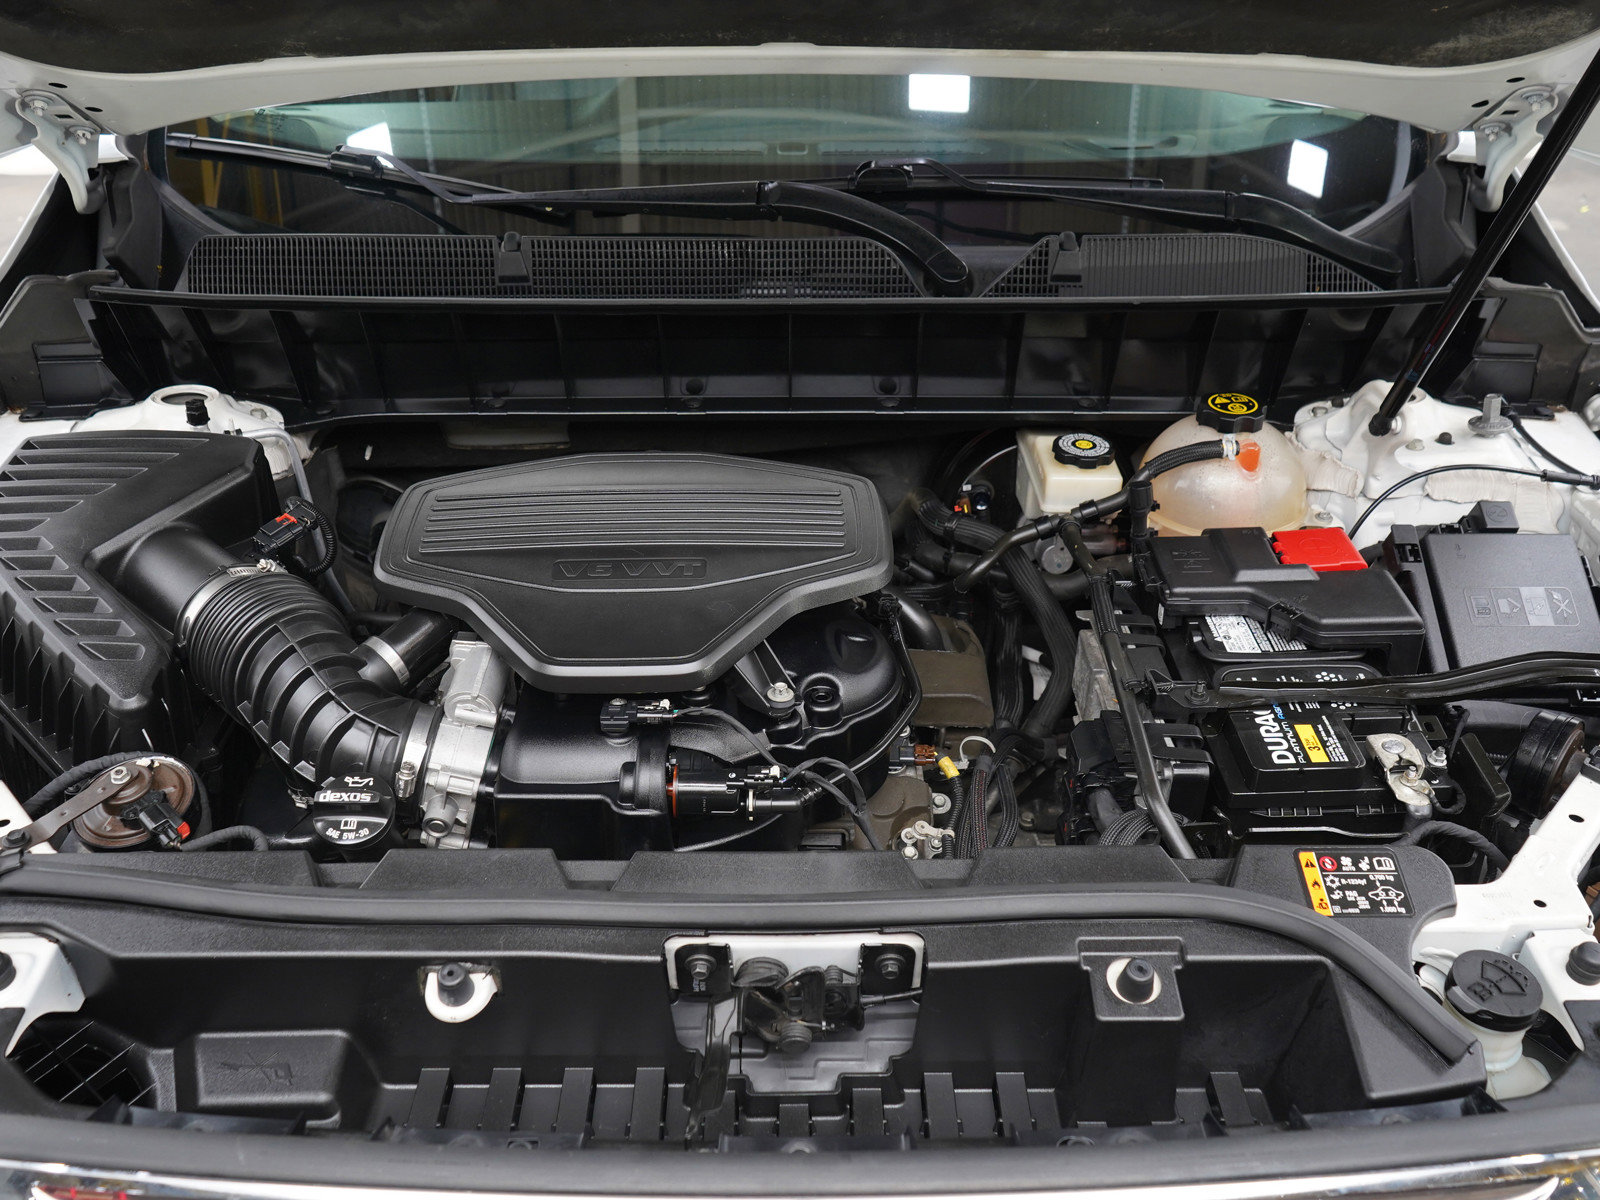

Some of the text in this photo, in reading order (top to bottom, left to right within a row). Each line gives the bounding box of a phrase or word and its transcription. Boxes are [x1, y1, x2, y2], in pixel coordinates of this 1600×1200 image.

[559, 561, 701, 577] V6 VVT
[1281, 721, 1307, 764] PLATINUM
[319, 790, 373, 802] dexos
[326, 827, 370, 840] SAE 5W-30
